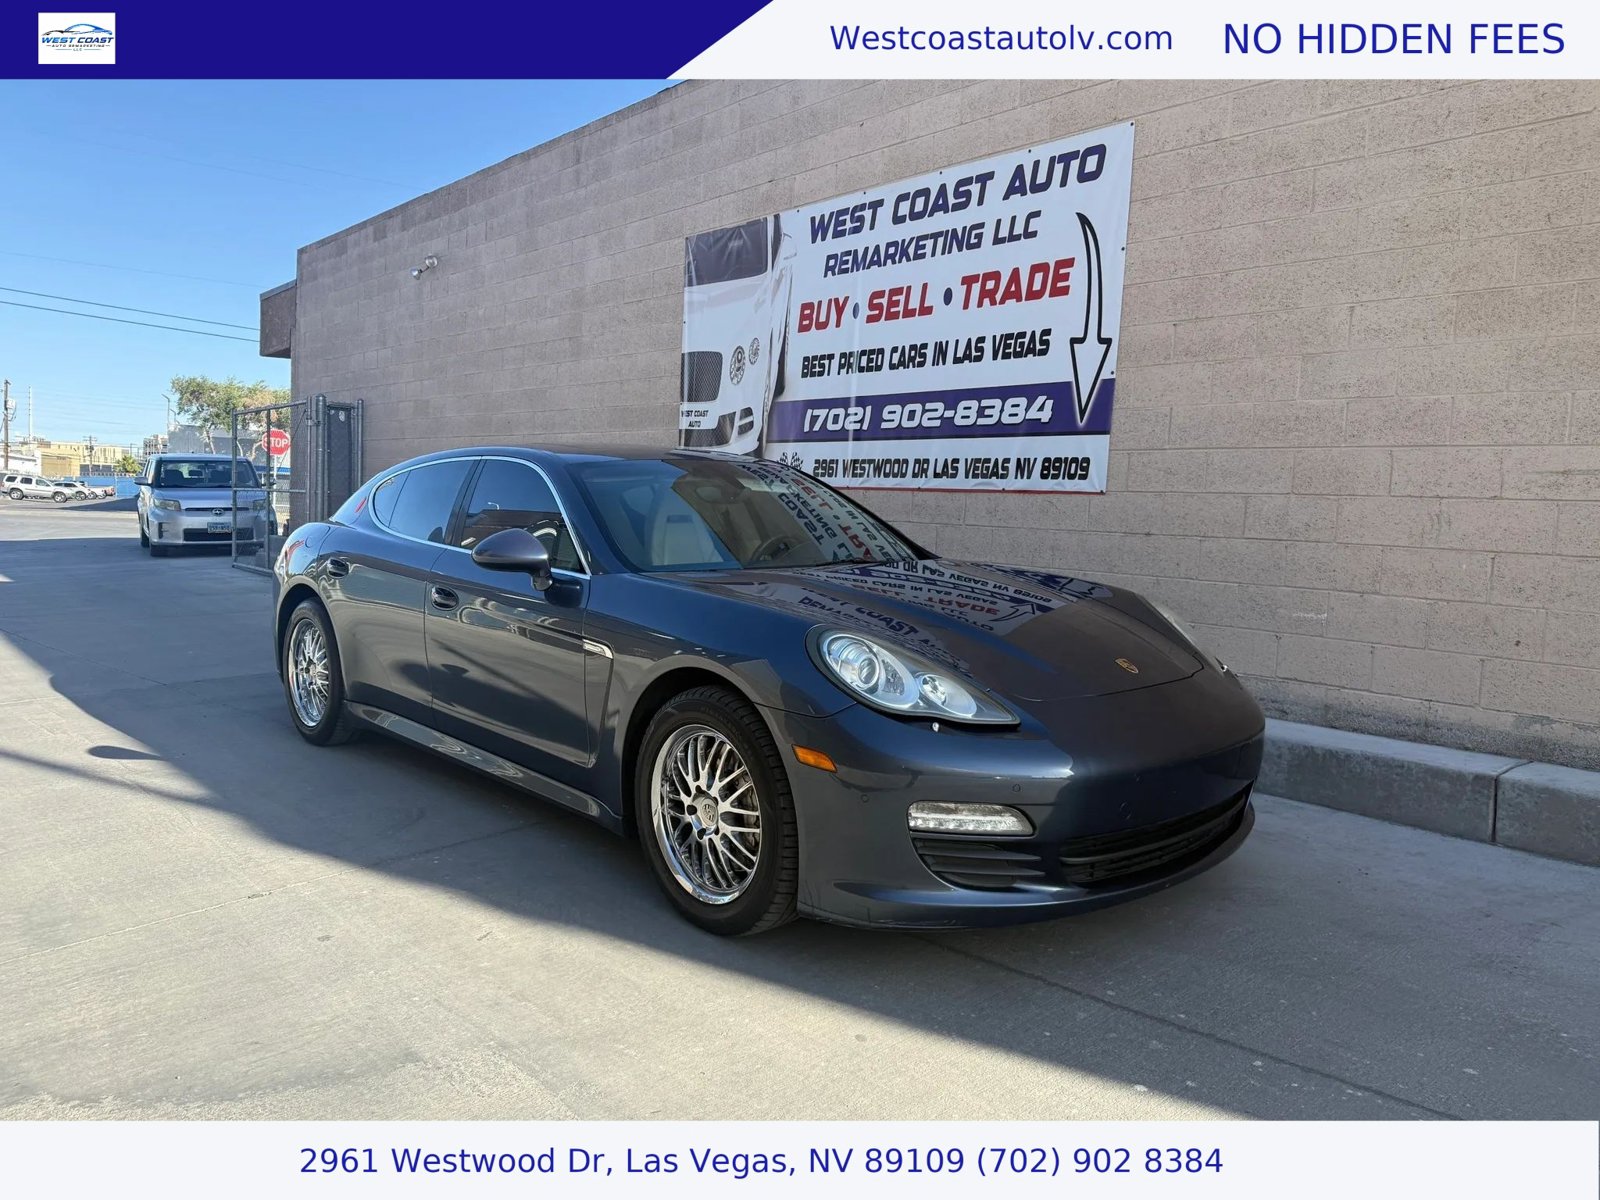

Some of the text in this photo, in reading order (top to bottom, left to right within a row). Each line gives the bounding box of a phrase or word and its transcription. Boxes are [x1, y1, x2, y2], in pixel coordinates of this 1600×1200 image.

[809, 143, 1107, 244] WEST COAST AUTO
[823, 209, 1042, 279] REMARKETING LLC
[797, 256, 1076, 334] BUY SELL TRADE
[800, 327, 1053, 379] BEST PRICED CARS IN LAS VEGAS
[880, 395, 1055, 430] 902-8384
[812, 458, 840, 478] 2961
[842, 457, 909, 479] WESTWOOD
[912, 457, 931, 479] DR
[932, 457, 960, 480] LAS
[964, 457, 1012, 480] VEGAS
[1014, 457, 1038, 480] NV
[1039, 456, 1091, 480] 89109
